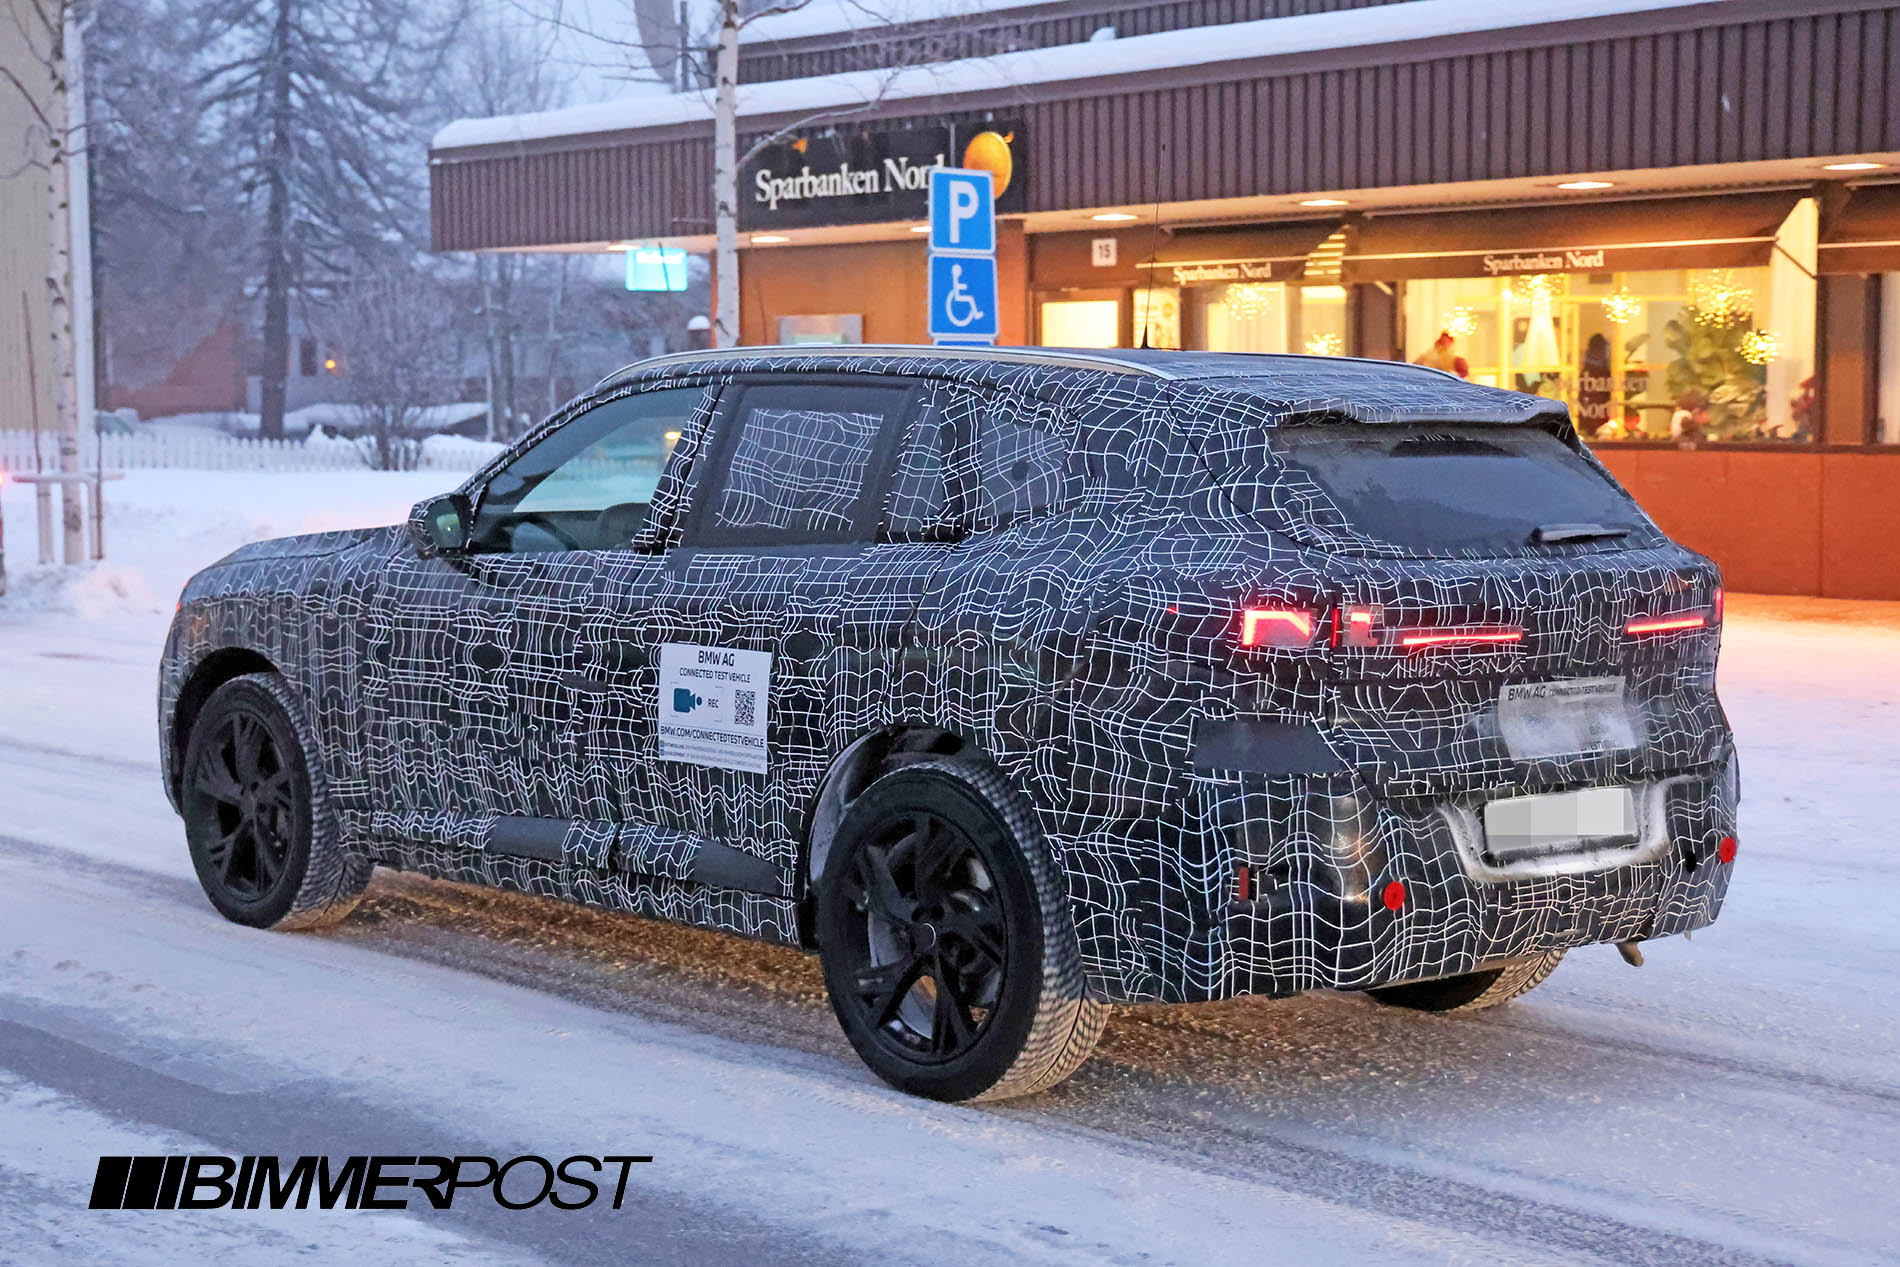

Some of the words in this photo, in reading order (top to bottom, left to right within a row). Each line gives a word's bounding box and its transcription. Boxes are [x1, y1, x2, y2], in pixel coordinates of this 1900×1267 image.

[755, 163, 879, 210] Sparbanken
[949, 180, 979, 244] P
[1240, 262, 1272, 279] Nord
[1483, 252, 1563, 276] Sparbanken
[1565, 249, 1604, 270] Nord
[698, 650, 721, 666] BMW
[722, 653, 735, 667] AG
[680, 667, 713, 680] CONNECTED
[714, 671, 728, 682] TEST
[728, 672, 751, 683] VEHICLE
[1508, 687, 1532, 701] BMW
[1533, 685, 1546, 698] AG
[707, 698, 719, 709] REC
[660, 725, 765, 749] BMW.COM/CONNECTEDTESTVEHICLE
